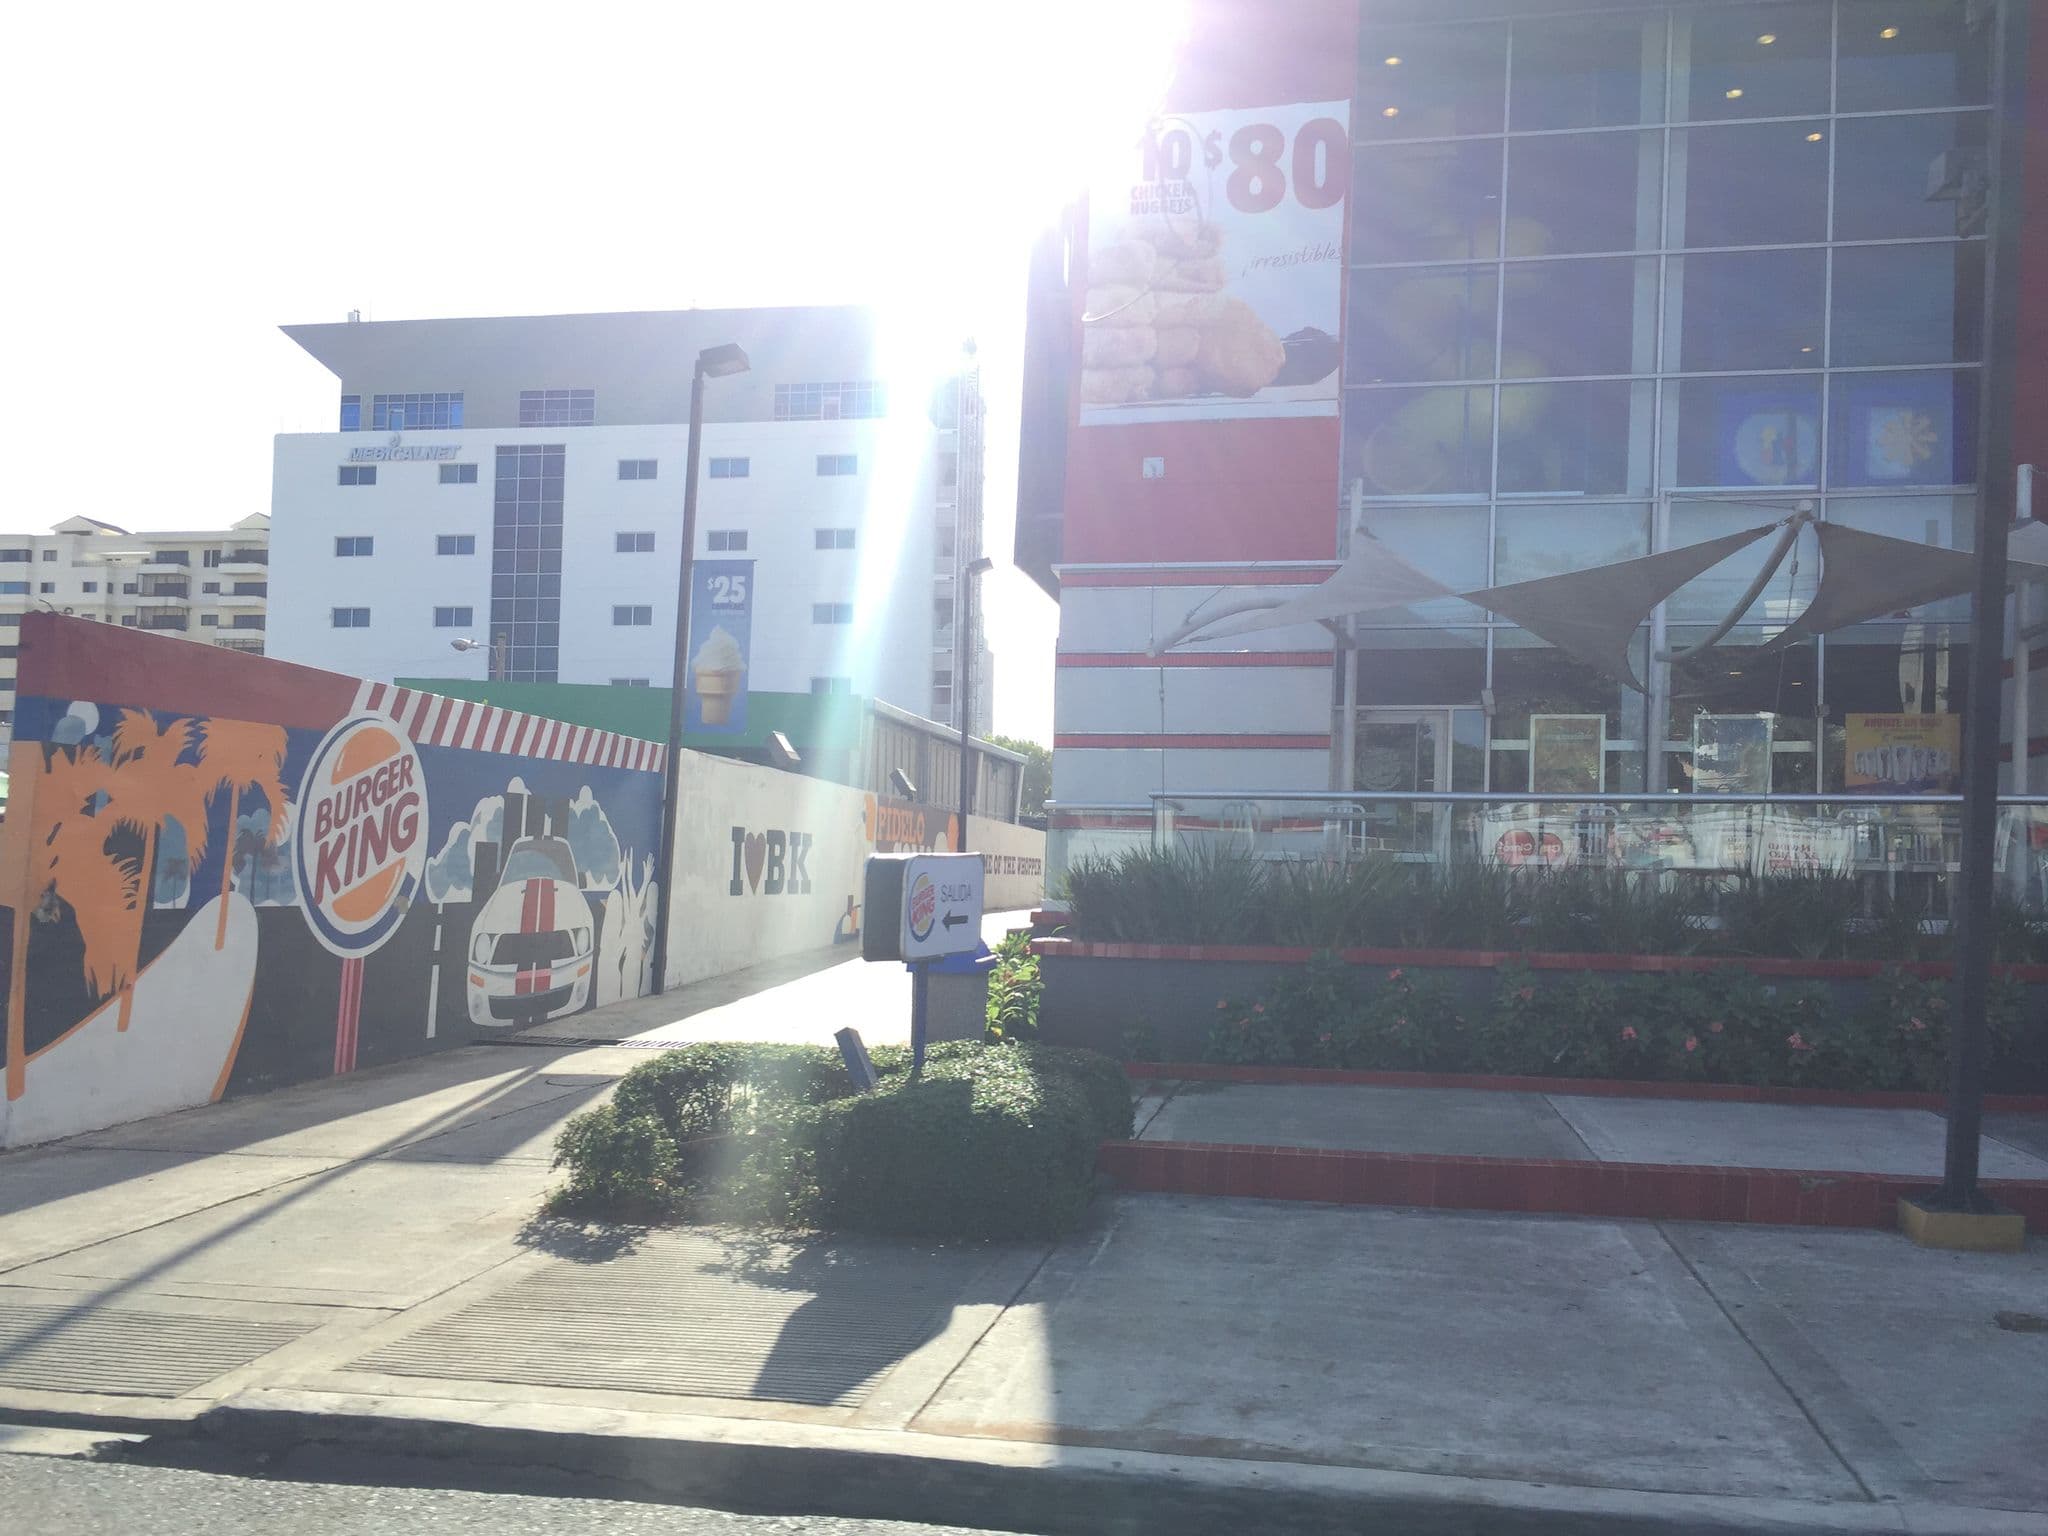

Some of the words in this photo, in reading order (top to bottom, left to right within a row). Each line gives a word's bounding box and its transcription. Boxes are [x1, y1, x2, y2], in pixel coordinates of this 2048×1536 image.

[1130, 183, 1193, 200] CHICKEN
[1130, 199, 1193, 215] NUGGETS
[707, 576, 746, 603] $25
[313, 754, 414, 843] BURGER
[314, 792, 420, 906] KING
[730, 826, 745, 896] I
[764, 829, 813, 895] BK
[1003, 856, 1016, 875] THE
[1017, 857, 1042, 876] WHOPPER
[912, 884, 935, 906] BURGER
[940, 884, 972, 903] SALIDA
[912, 897, 936, 924] KING
